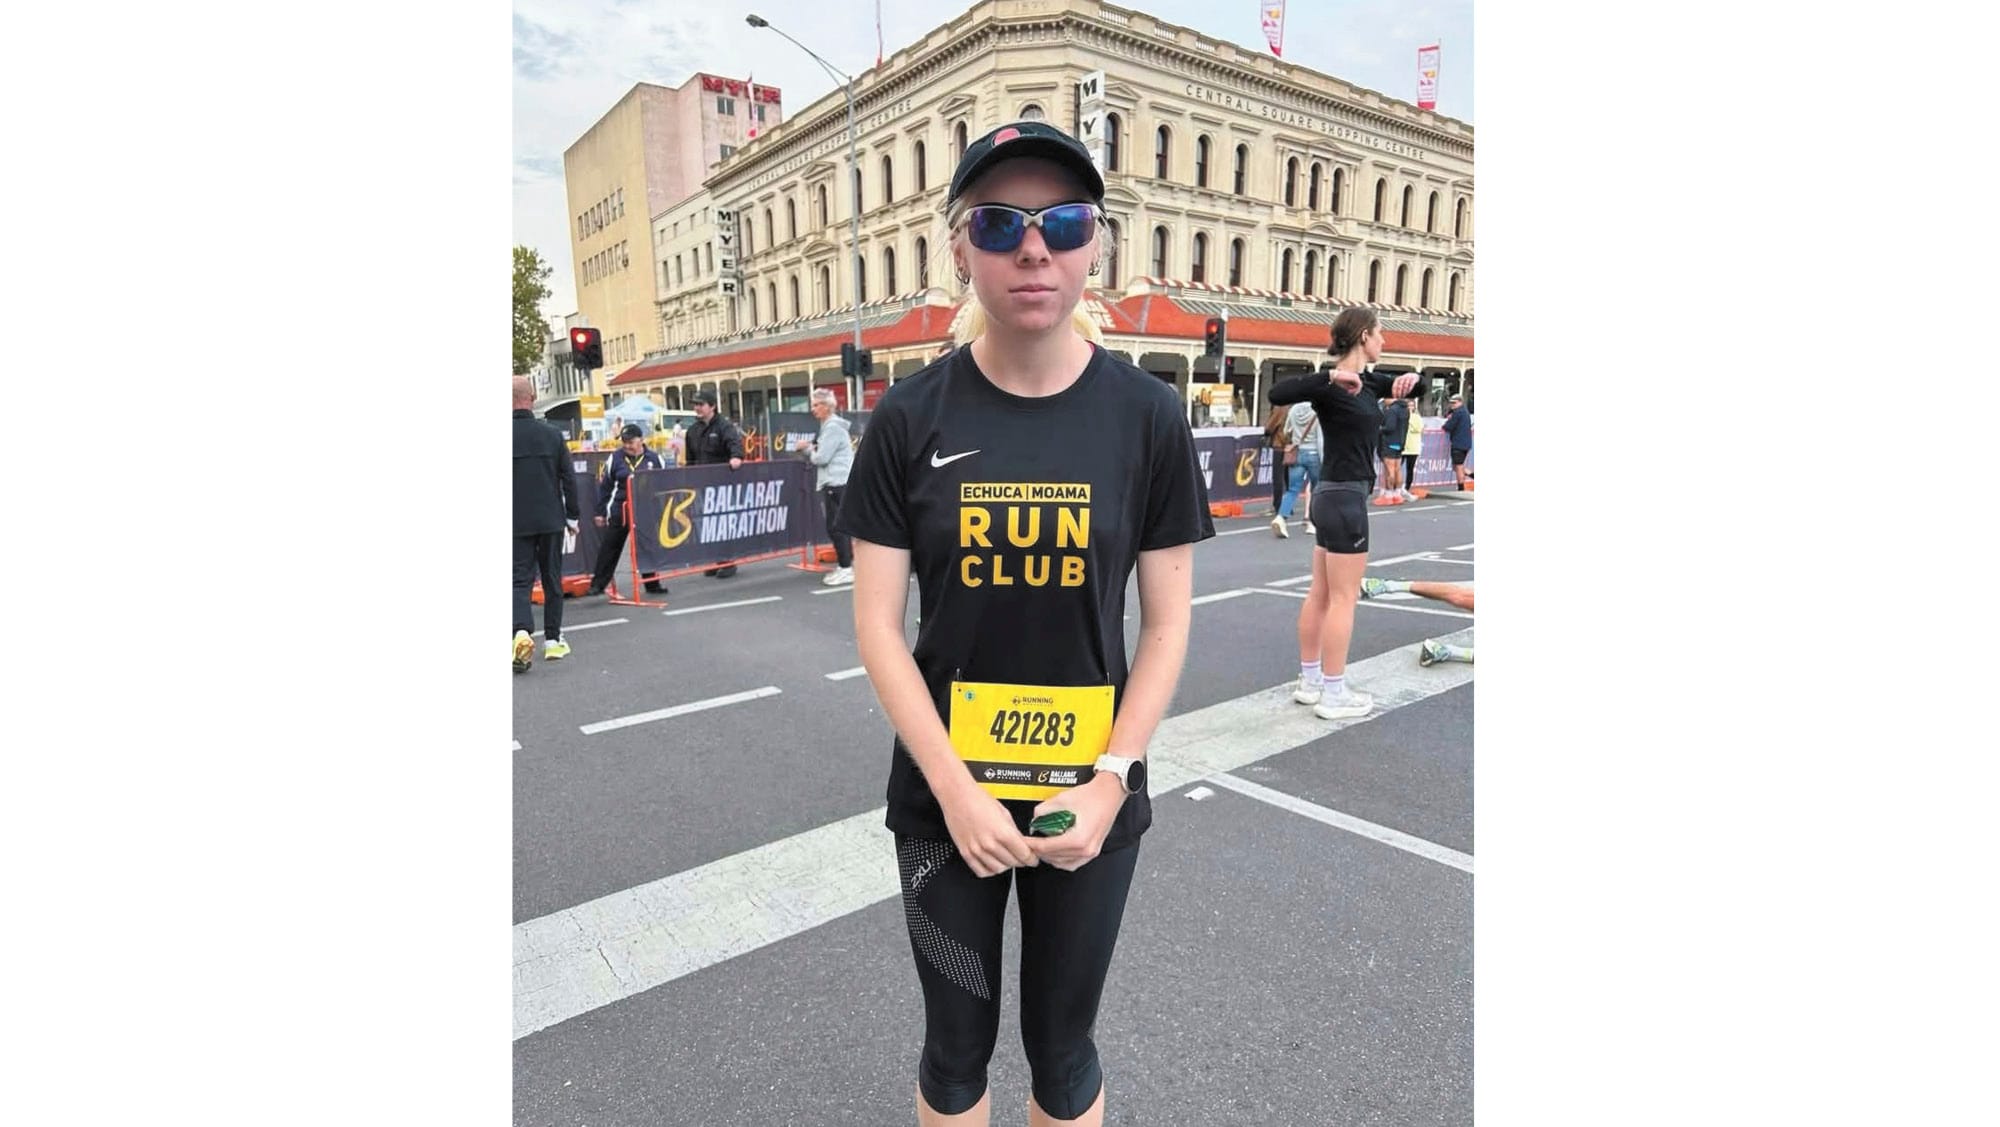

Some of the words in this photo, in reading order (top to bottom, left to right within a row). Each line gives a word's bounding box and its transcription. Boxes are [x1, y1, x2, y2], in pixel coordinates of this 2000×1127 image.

[871, 99, 912, 129] CENTRE
[1186, 84, 1253, 113] CENTRAL
[1262, 105, 1313, 130] SQUARE
[1321, 121, 1380, 148] SHOPPING
[1385, 141, 1425, 161] CENTRE
[718, 210, 736, 293] MYER
[703, 480, 785, 516] BALLARAT
[963, 486, 1023, 499] ECHUCA
[1032, 486, 1088, 500] MOAMA
[700, 506, 788, 545] MARATHON
[960, 506, 1091, 549] RUN
[960, 554, 1086, 588] CLUB
[1022, 696, 1054, 705] RUNNING
[989, 709, 1077, 746] 421283
[996, 769, 1032, 779] RUNNING
[1050, 770, 1078, 779] BALLARAT
